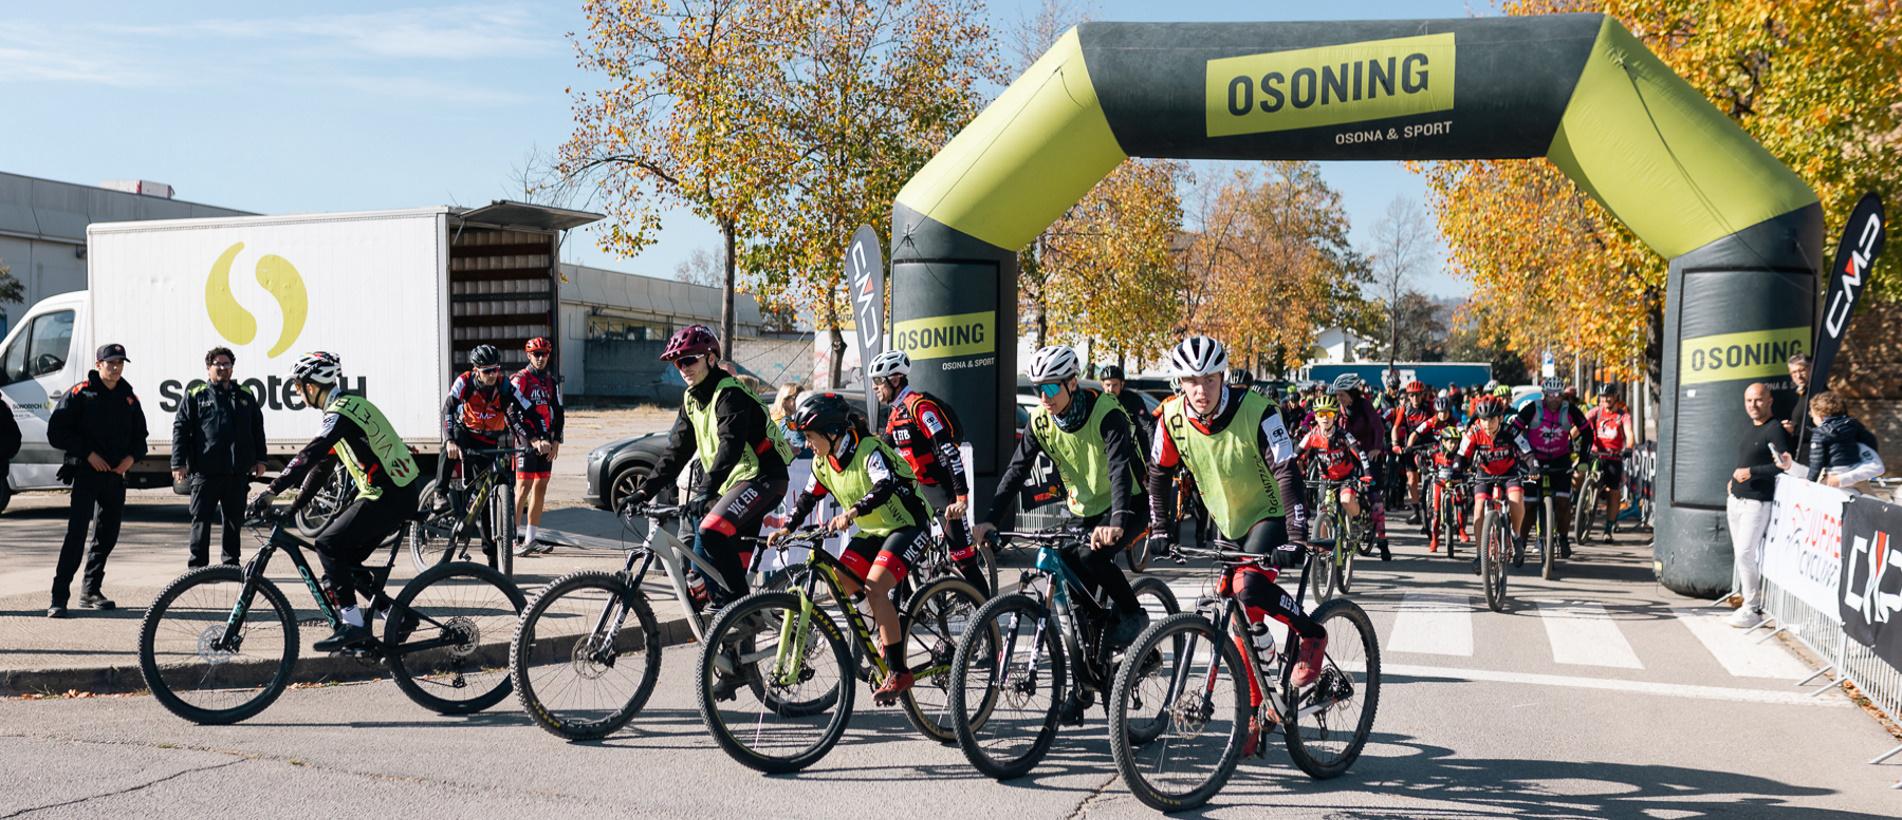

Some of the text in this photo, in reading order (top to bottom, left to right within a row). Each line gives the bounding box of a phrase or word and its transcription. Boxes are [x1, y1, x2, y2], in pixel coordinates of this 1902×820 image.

[1227, 52, 1429, 116] OSONING
[1335, 120, 1453, 145] OSONA & SPORT
[898, 323, 984, 351] OSONING
[942, 360, 966, 371] OSONA
[975, 356, 995, 367] SPORT
[727, 498, 747, 516] VIC
[743, 487, 759, 504] ETB
[902, 530, 931, 562] VIC ETB
